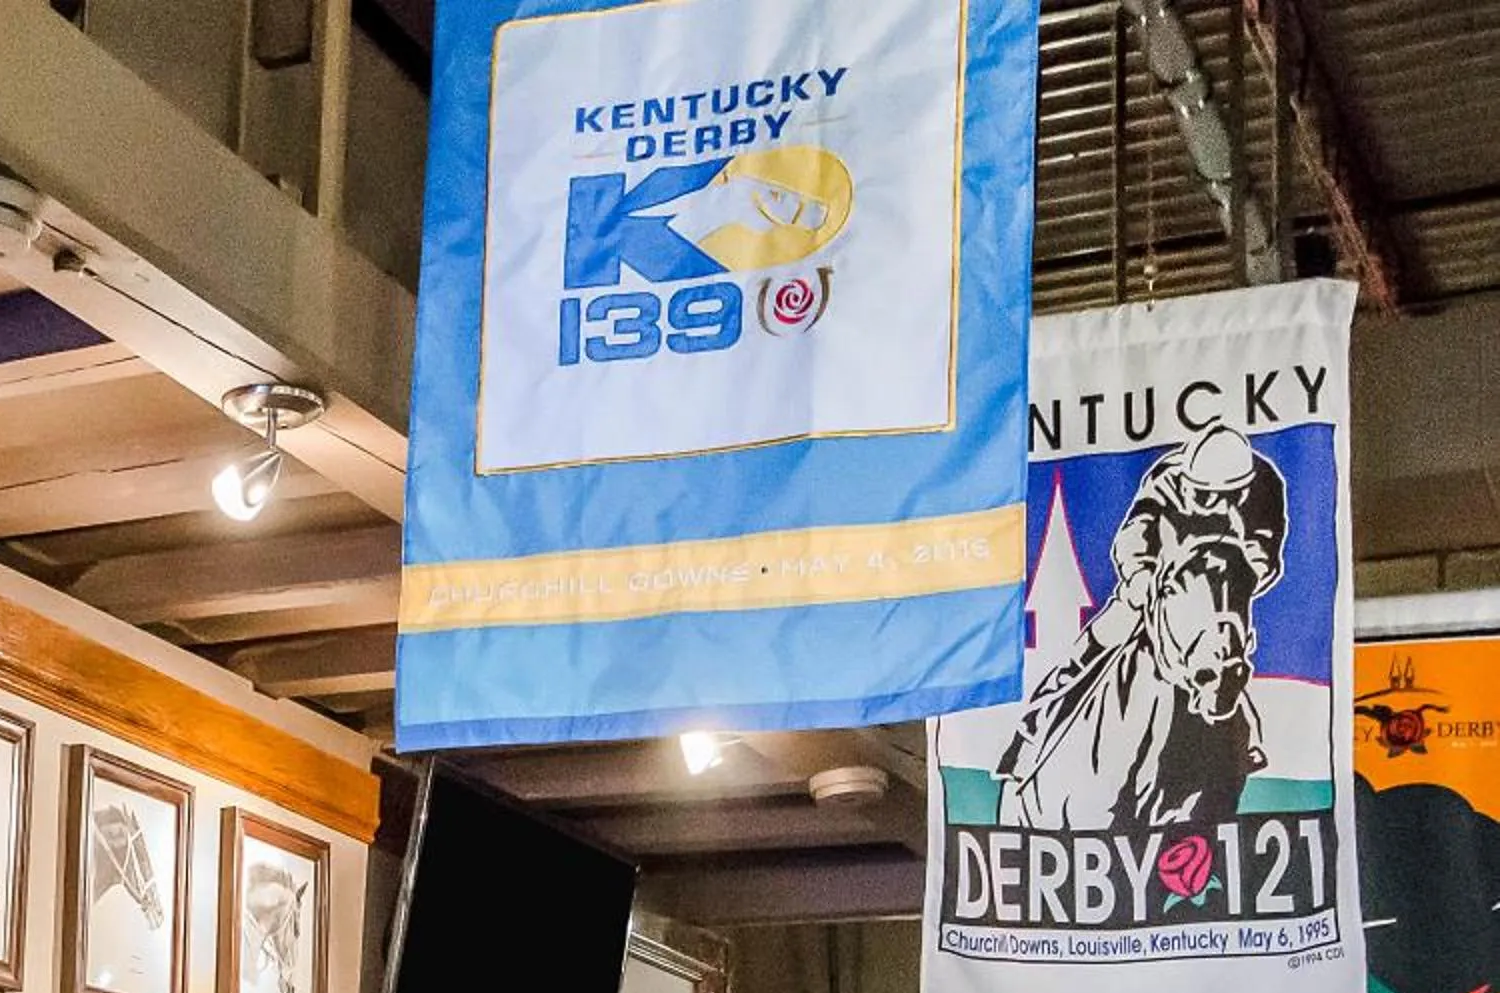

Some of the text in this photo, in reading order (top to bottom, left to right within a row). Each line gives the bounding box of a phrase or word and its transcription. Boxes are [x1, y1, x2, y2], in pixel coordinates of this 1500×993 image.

[574, 67, 848, 133] KENTUCKY
[625, 110, 793, 162] DERBY
[558, 281, 743, 366] 139
[1028, 365, 1327, 452] NTUCKY
[781, 554, 850, 578] MAY
[1437, 720, 1500, 738] DERB
[954, 819, 1326, 924] DERBY 121
[1010, 935, 1063, 958] Downs,
[1068, 934, 1147, 956] Louisville,
[1150, 929, 1229, 953] Kentucky
[1239, 927, 1273, 952] May
[1278, 928, 1294, 949] 6,
[1298, 917, 1330, 944] 1995
